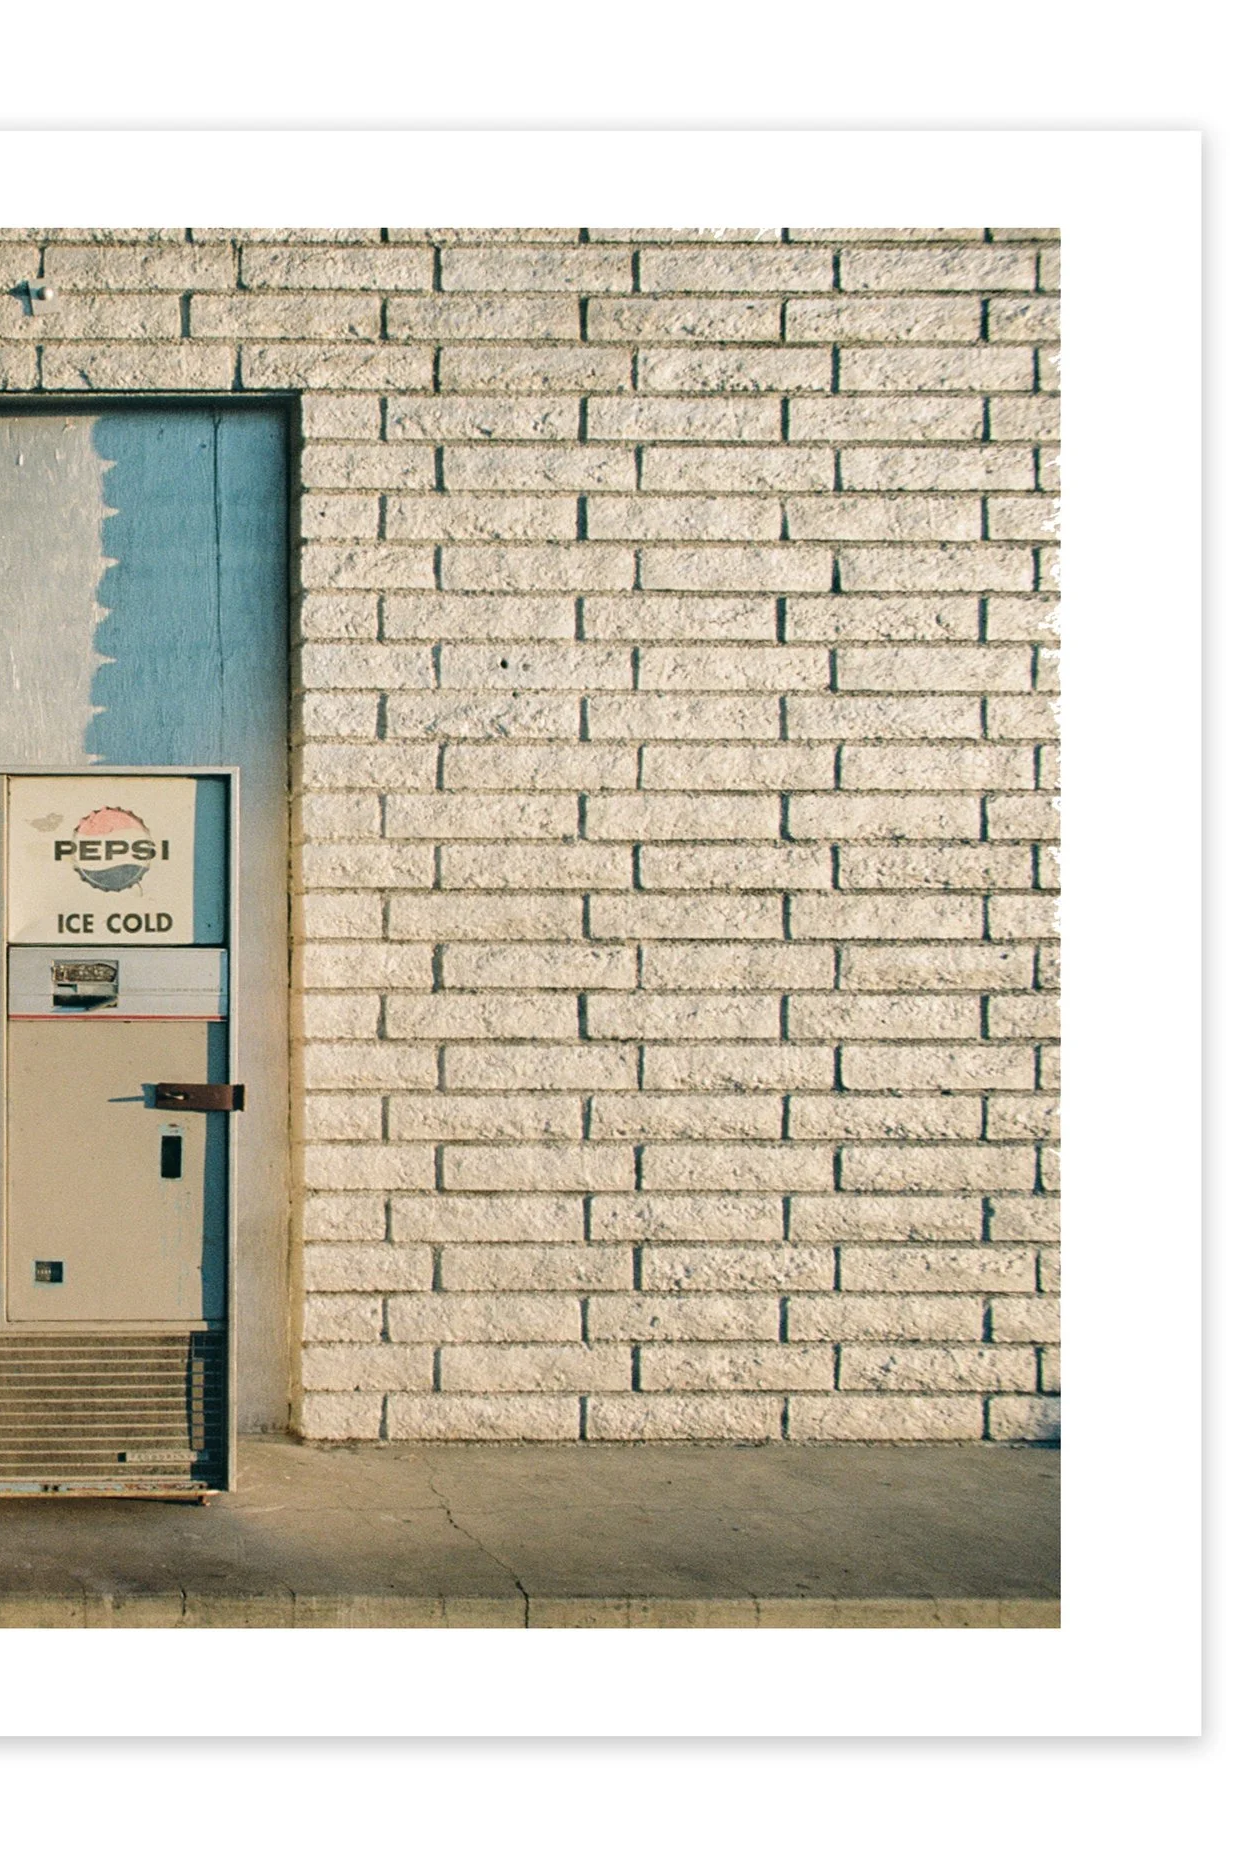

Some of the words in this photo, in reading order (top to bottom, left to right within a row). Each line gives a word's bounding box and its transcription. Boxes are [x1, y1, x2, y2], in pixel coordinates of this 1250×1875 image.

[54, 839, 169, 861] PEPSI
[57, 913, 95, 934] ICE
[106, 912, 173, 934] COLD
